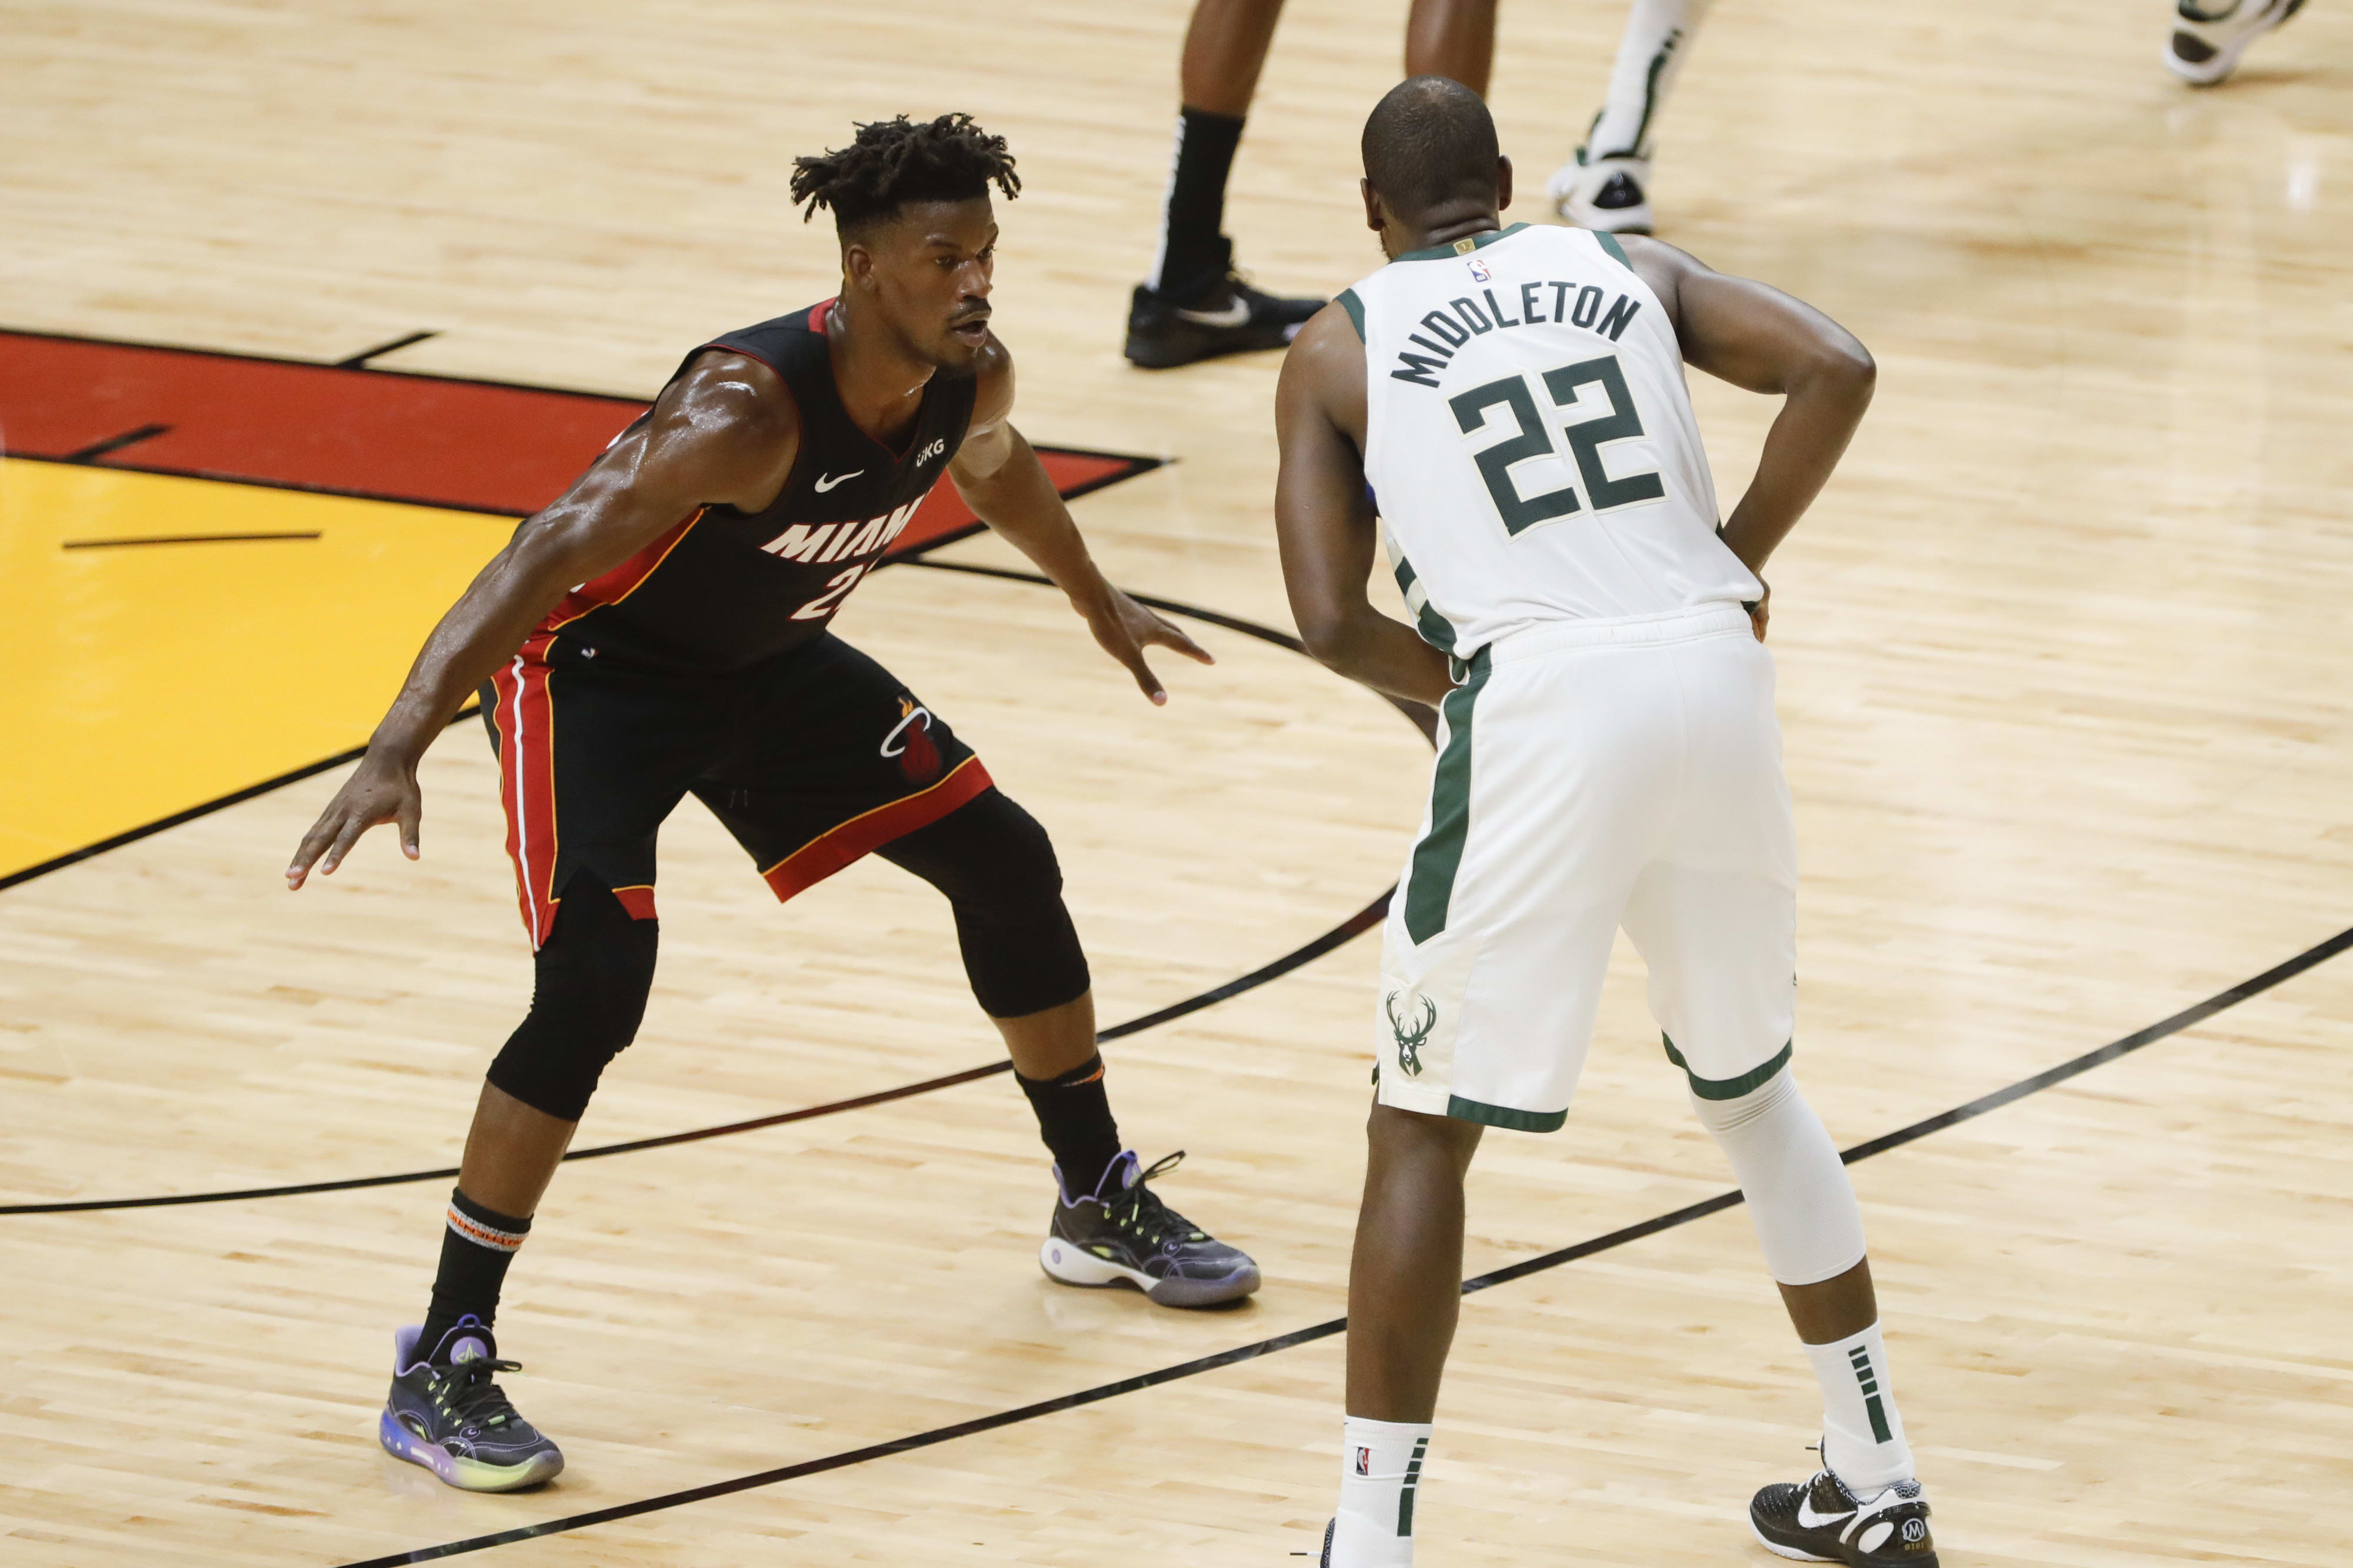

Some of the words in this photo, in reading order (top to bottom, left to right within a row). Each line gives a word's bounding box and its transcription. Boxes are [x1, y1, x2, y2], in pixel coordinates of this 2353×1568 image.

[1390, 281, 1642, 388] MIDDLETON
[916, 438, 944, 467] UKG
[1447, 353, 1671, 543] 22
[759, 486, 934, 563] MIAM
[789, 556, 881, 620] 2
